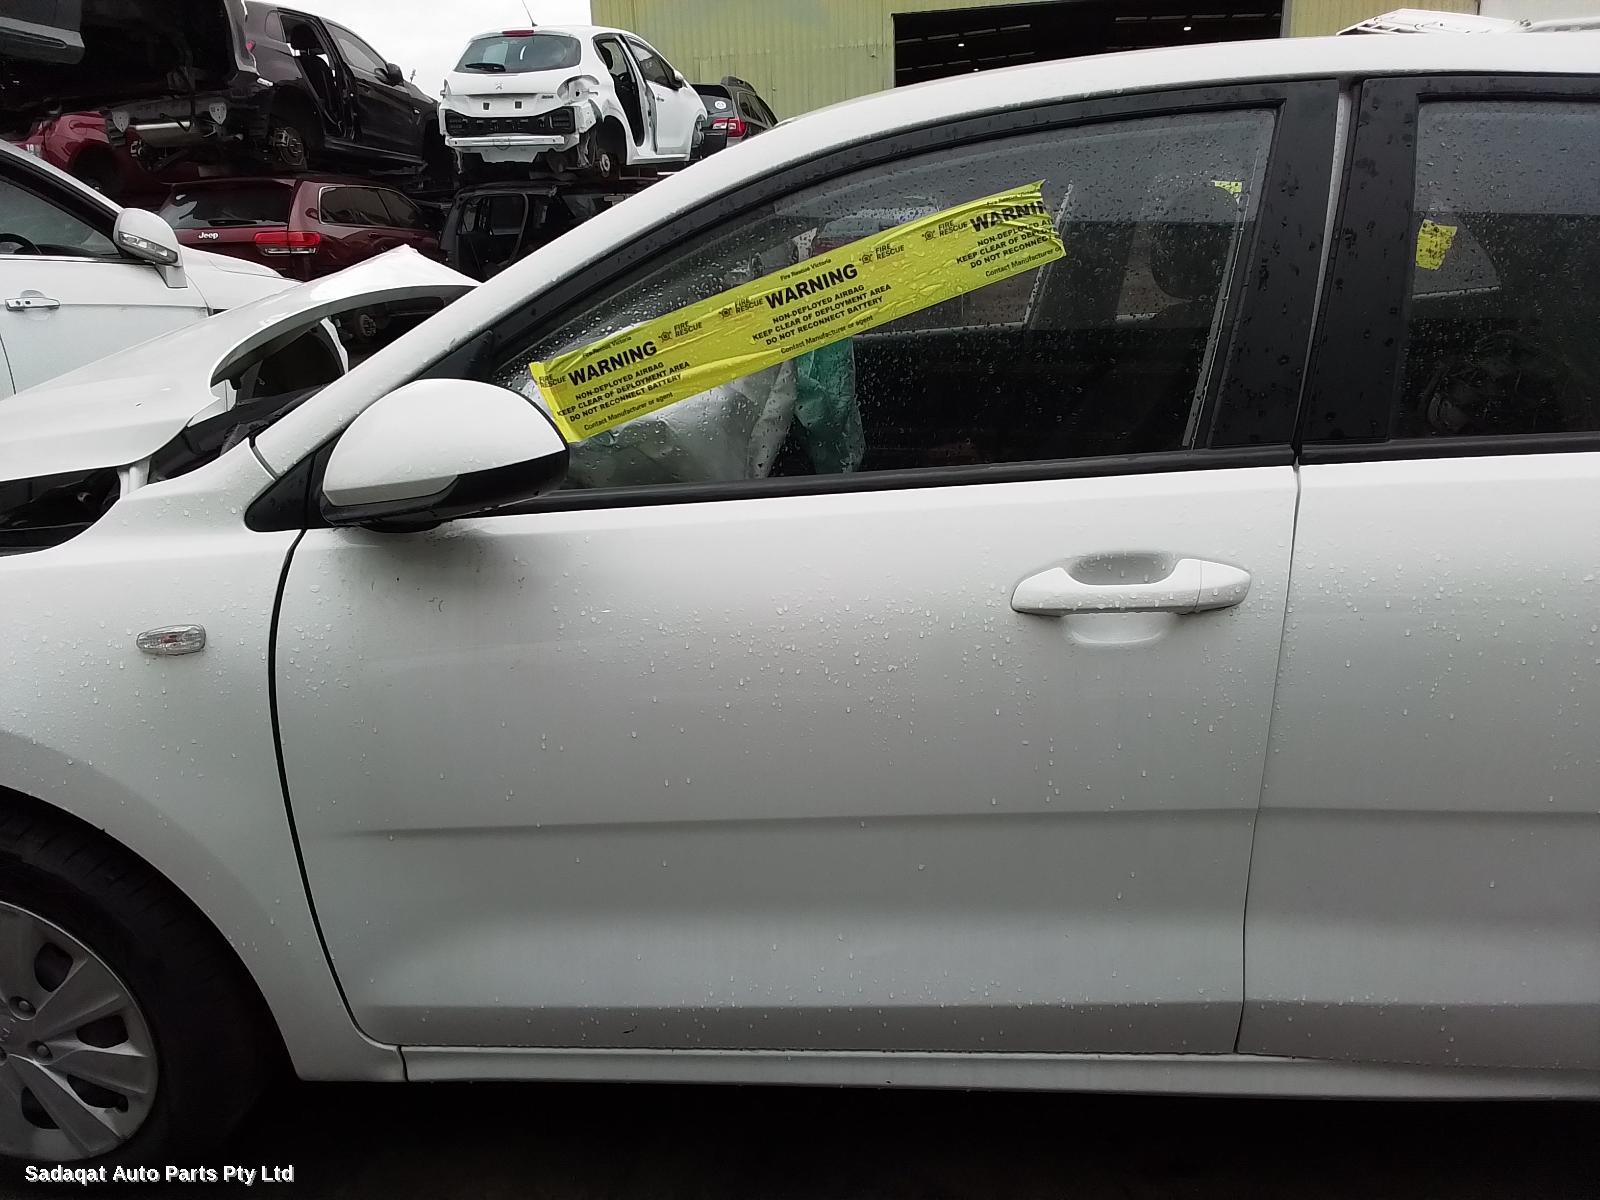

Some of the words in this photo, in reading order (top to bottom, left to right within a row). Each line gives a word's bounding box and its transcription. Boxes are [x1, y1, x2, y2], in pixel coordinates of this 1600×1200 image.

[938, 220, 954, 231] FIRE
[939, 221, 968, 237] RESCUE
[875, 243, 891, 254] FIRE
[876, 245, 905, 260] RESCUE
[956, 252, 978, 264] KEEP
[979, 241, 1007, 256] CLEAR
[1008, 236, 1019, 246] OF
[970, 259, 982, 269] DO
[984, 252, 1001, 264] NOT
[780, 271, 791, 281] Fire
[811, 258, 832, 269] Victoria
[985, 264, 1011, 277] Contact
[1011, 249, 1054, 269] Manufacturer
[765, 264, 858, 310] WARNING
[736, 298, 764, 314] RESCUE
[752, 328, 773, 342] KEEP
[775, 318, 801, 333] CLEAR
[802, 312, 813, 322] OF
[815, 292, 867, 317] DEPLOYMENT
[870, 284, 892, 296] AREA
[772, 296, 833, 325] NON-DEPLOYED
[834, 284, 865, 302] AIRBAG
[674, 321, 689, 331] FIRE
[675, 322, 703, 337] RESCUE
[766, 335, 777, 346] DO
[779, 329, 796, 341] NOT
[797, 311, 845, 334] RECONNECT
[847, 296, 883, 315] BATTERY
[780, 341, 805, 354] Contact
[805, 325, 846, 346] Manufacturer
[855, 315, 874, 327] agent
[568, 341, 658, 386] WARNING
[557, 404, 577, 417] KEEP
[578, 394, 604, 409] CLEAR
[605, 389, 615, 399] OF
[616, 370, 667, 395] DEPLOYMENT
[669, 361, 690, 374] AREA
[575, 371, 637, 400] NON-DEPLOYED
[635, 362, 665, 379] AIRBAG
[569, 412, 581, 423] DO
[582, 405, 598, 417] NOT
[600, 388, 646, 410] RECONNECT
[648, 374, 682, 391] BATTERY
[584, 418, 607, 431] Contact
[607, 403, 647, 423] Manufacturer
[656, 392, 674, 404] agent
